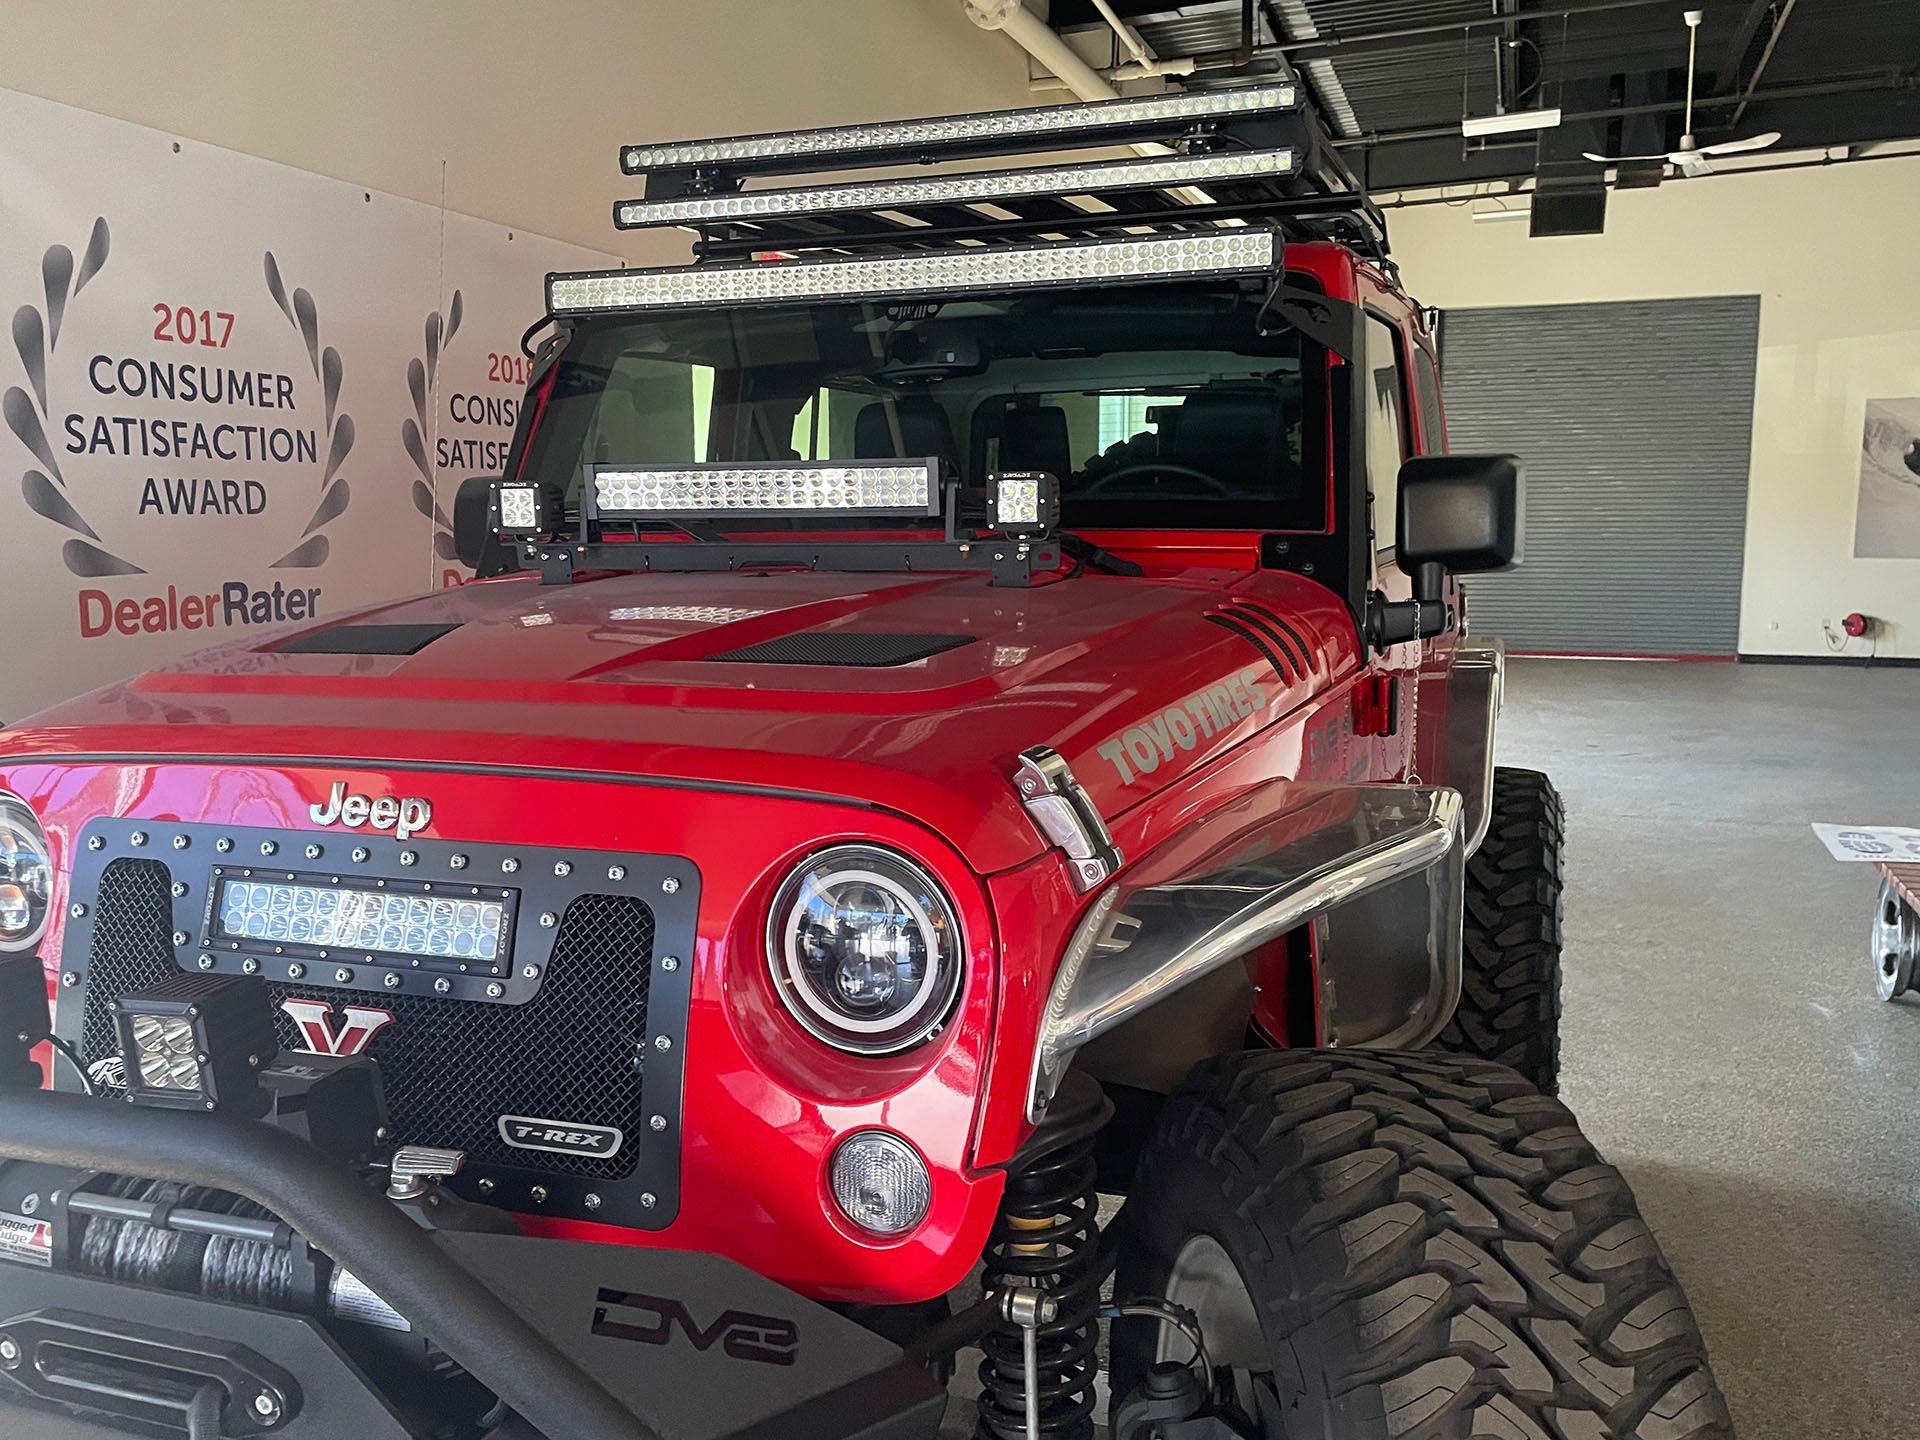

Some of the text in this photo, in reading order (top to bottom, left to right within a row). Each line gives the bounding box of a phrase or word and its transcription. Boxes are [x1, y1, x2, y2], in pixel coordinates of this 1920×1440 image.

[153, 303, 236, 348] 2017
[89, 355, 296, 410] CONSUMER
[64, 413, 317, 463] SATISFACTION
[138, 477, 267, 515] AWARD
[79, 581, 322, 638] DealerRater
[1097, 669, 1266, 786] TOYO TIRES
[309, 781, 432, 841] Jeep
[515, 1125, 604, 1147] T-REX
